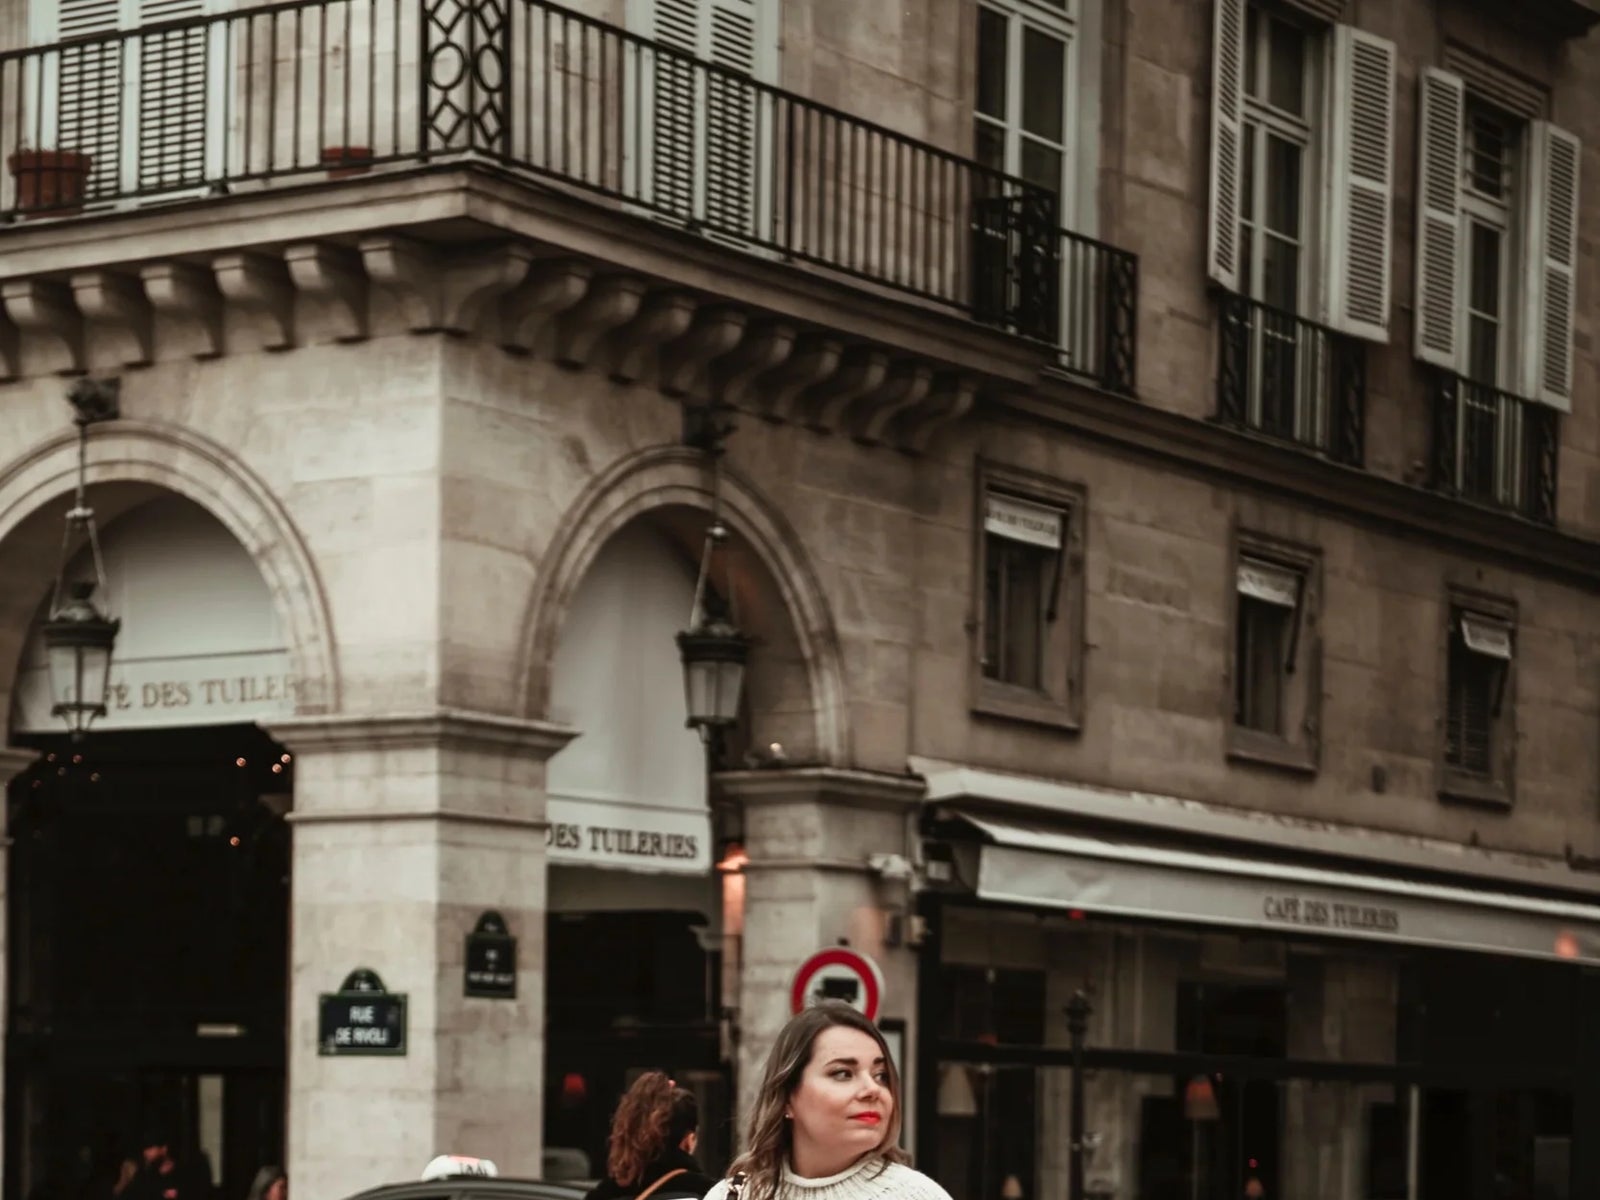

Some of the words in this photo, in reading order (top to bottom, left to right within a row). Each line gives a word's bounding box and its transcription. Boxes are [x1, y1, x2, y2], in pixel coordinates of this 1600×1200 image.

[142, 679, 191, 709] DES
[587, 825, 699, 859] TUILERIES
[1263, 894, 1300, 923] CAFÉ
[1303, 899, 1329, 926] DES
[1332, 903, 1400, 932] TUILERIES
[349, 1004, 375, 1024] RUE
[335, 1026, 351, 1046] DE
